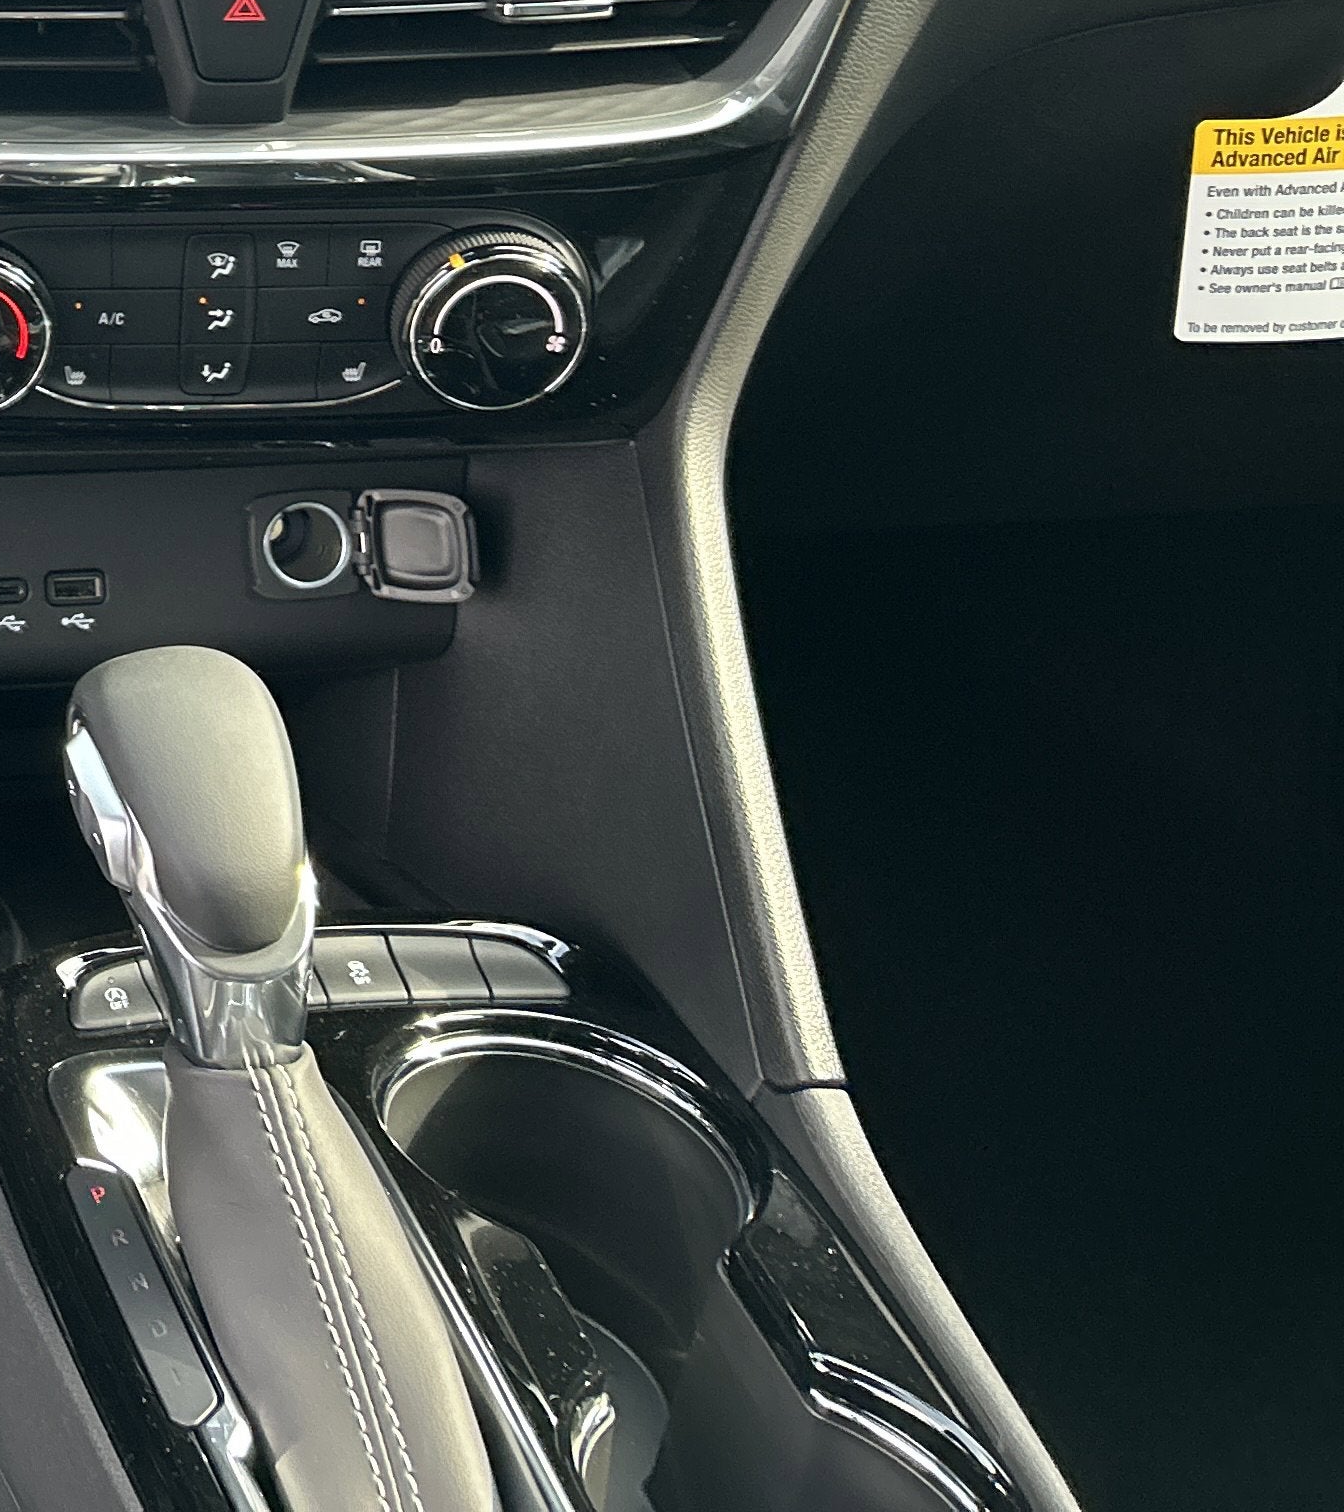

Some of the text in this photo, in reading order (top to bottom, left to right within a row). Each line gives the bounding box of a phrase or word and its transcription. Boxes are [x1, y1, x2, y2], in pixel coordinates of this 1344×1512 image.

[1212, 128, 1255, 146] This
[1261, 125, 1330, 145] Vehicle
[1211, 146, 1341, 168] Advanced Air
[1207, 185, 1240, 197] Even
[1243, 184, 1272, 197] with
[1274, 181, 1338, 196] Advanced
[1216, 208, 1269, 220] Children
[1273, 209, 1296, 219] can
[1299, 206, 1315, 218] be
[1214, 227, 1238, 239] The
[1240, 226, 1270, 239] back
[1273, 225, 1299, 237] seat
[1301, 224, 1312, 236] is
[1314, 224, 1334, 236] the
[1212, 246, 1250, 257] Never
[1251, 245, 1273, 259] put
[1274, 246, 1282, 256] a
[275, 257, 299, 269] MAX
[357, 256, 383, 268] REAR
[1210, 264, 1254, 278] Always
[1257, 265, 1280, 275] use
[1282, 262, 1308, 274] seat
[1310, 261, 1338, 273] belts
[1208, 279, 1327, 294] See owner's manual
[97, 312, 127, 326] A/C
[1187, 321, 1201, 333] To
[1203, 322, 1218, 333] be
[1220, 321, 1270, 334] removed
[1272, 322, 1287, 335] by
[1288, 320, 1339, 332] customer
[90, 1185, 106, 1205] P
[111, 1229, 129, 1248] R
